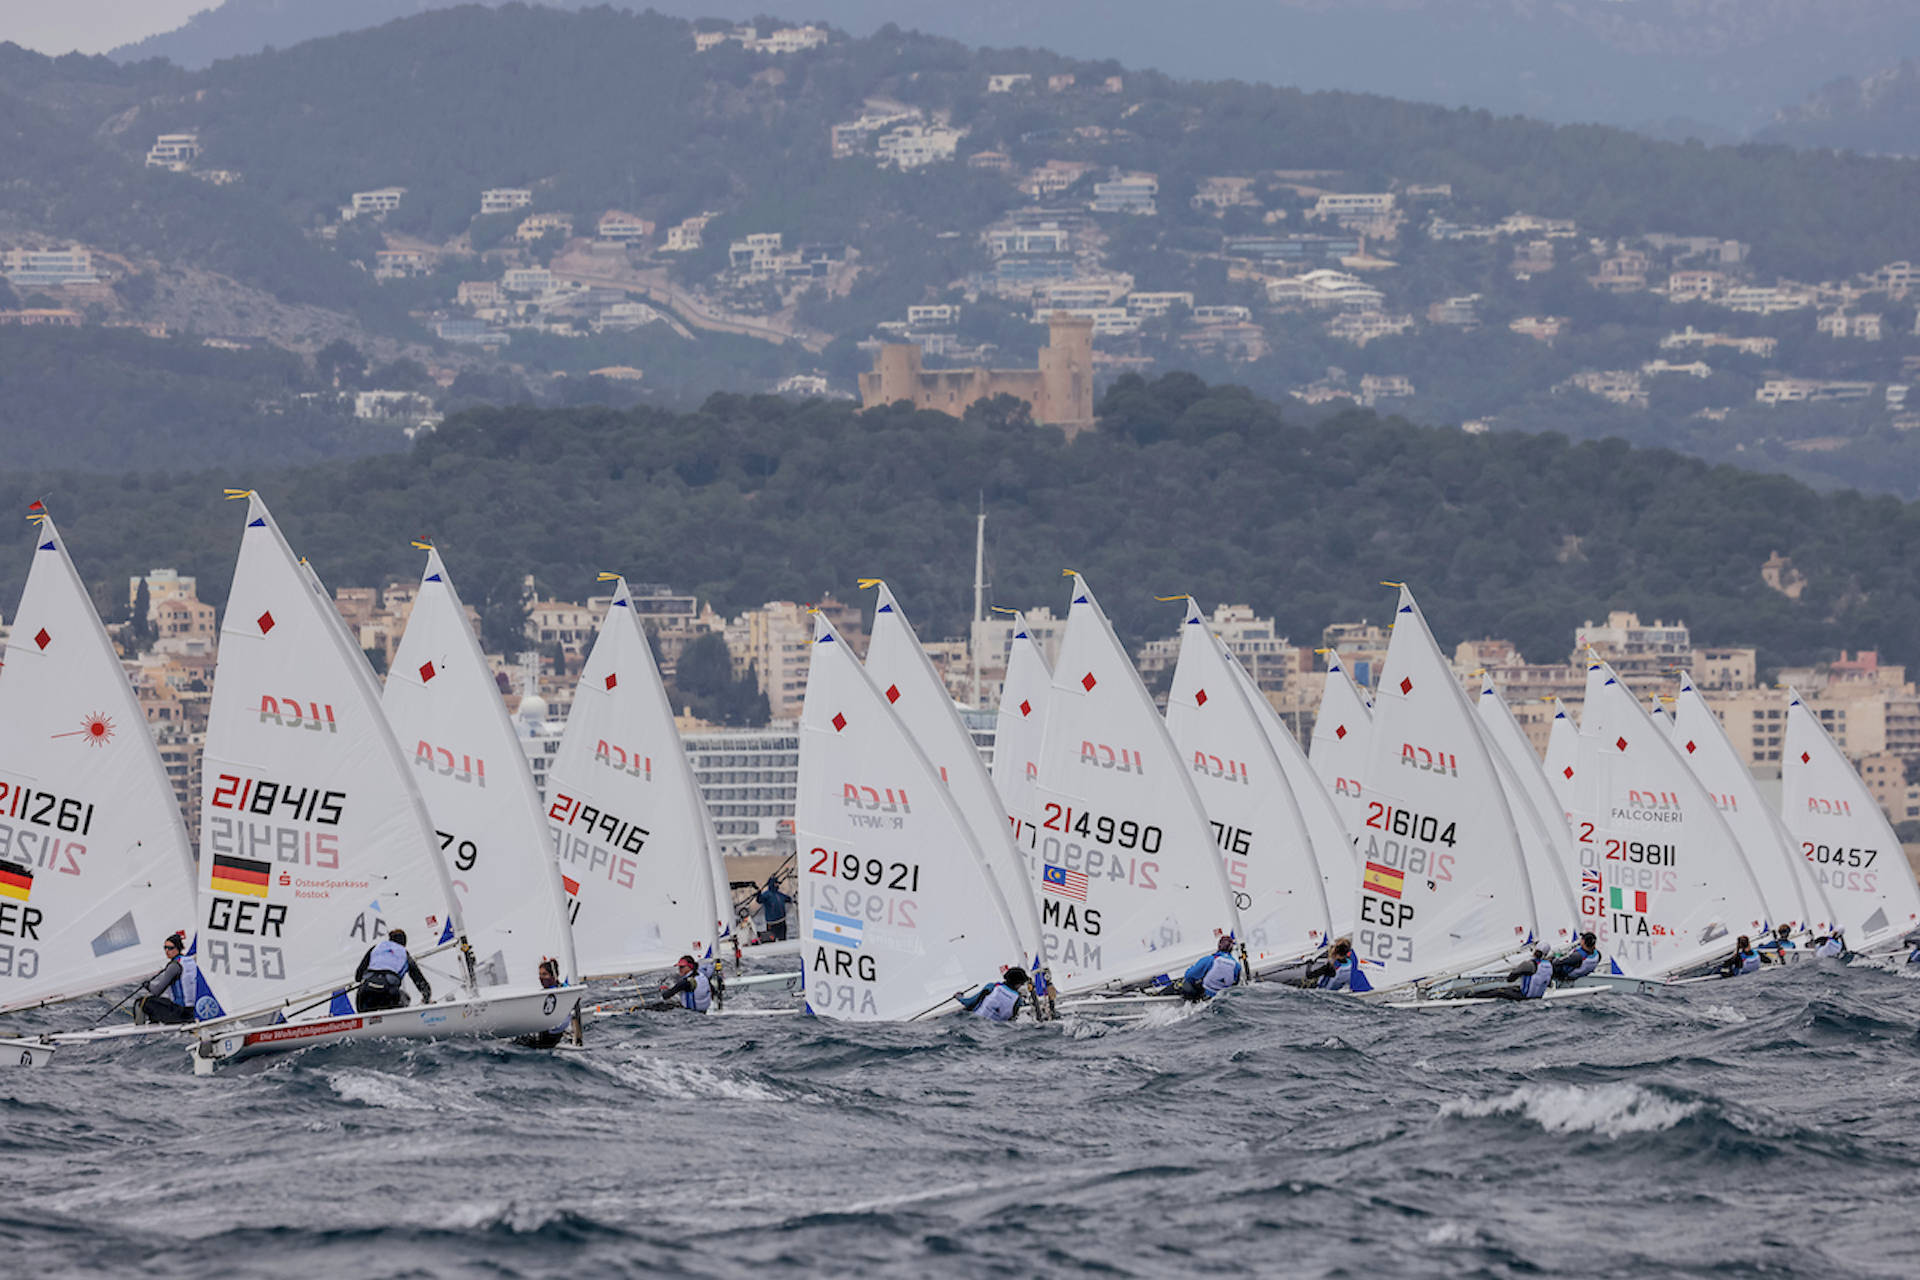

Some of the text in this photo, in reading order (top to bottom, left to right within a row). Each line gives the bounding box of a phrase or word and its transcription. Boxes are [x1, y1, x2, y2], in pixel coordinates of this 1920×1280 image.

[211, 774, 346, 825] 218415
[1611, 808, 1683, 823] FALCONERI
[548, 793, 650, 855] 219916
[1043, 802, 1162, 854] 214990
[1366, 801, 1457, 848] 216104
[808, 847, 919, 892] 219921
[1605, 839, 1675, 866] 219811
[1802, 842, 1877, 868] 20457
[295, 878, 369, 889] OstseeSparkasse
[295, 889, 330, 899] Rostock
[0, 902, 43, 941] ER
[208, 897, 287, 937] GER
[1043, 898, 1102, 936] MAS
[1361, 896, 1414, 929] ESP
[1613, 913, 1650, 936] ITA
[814, 946, 877, 982] ARG
[259, 1032, 273, 1041] Die
